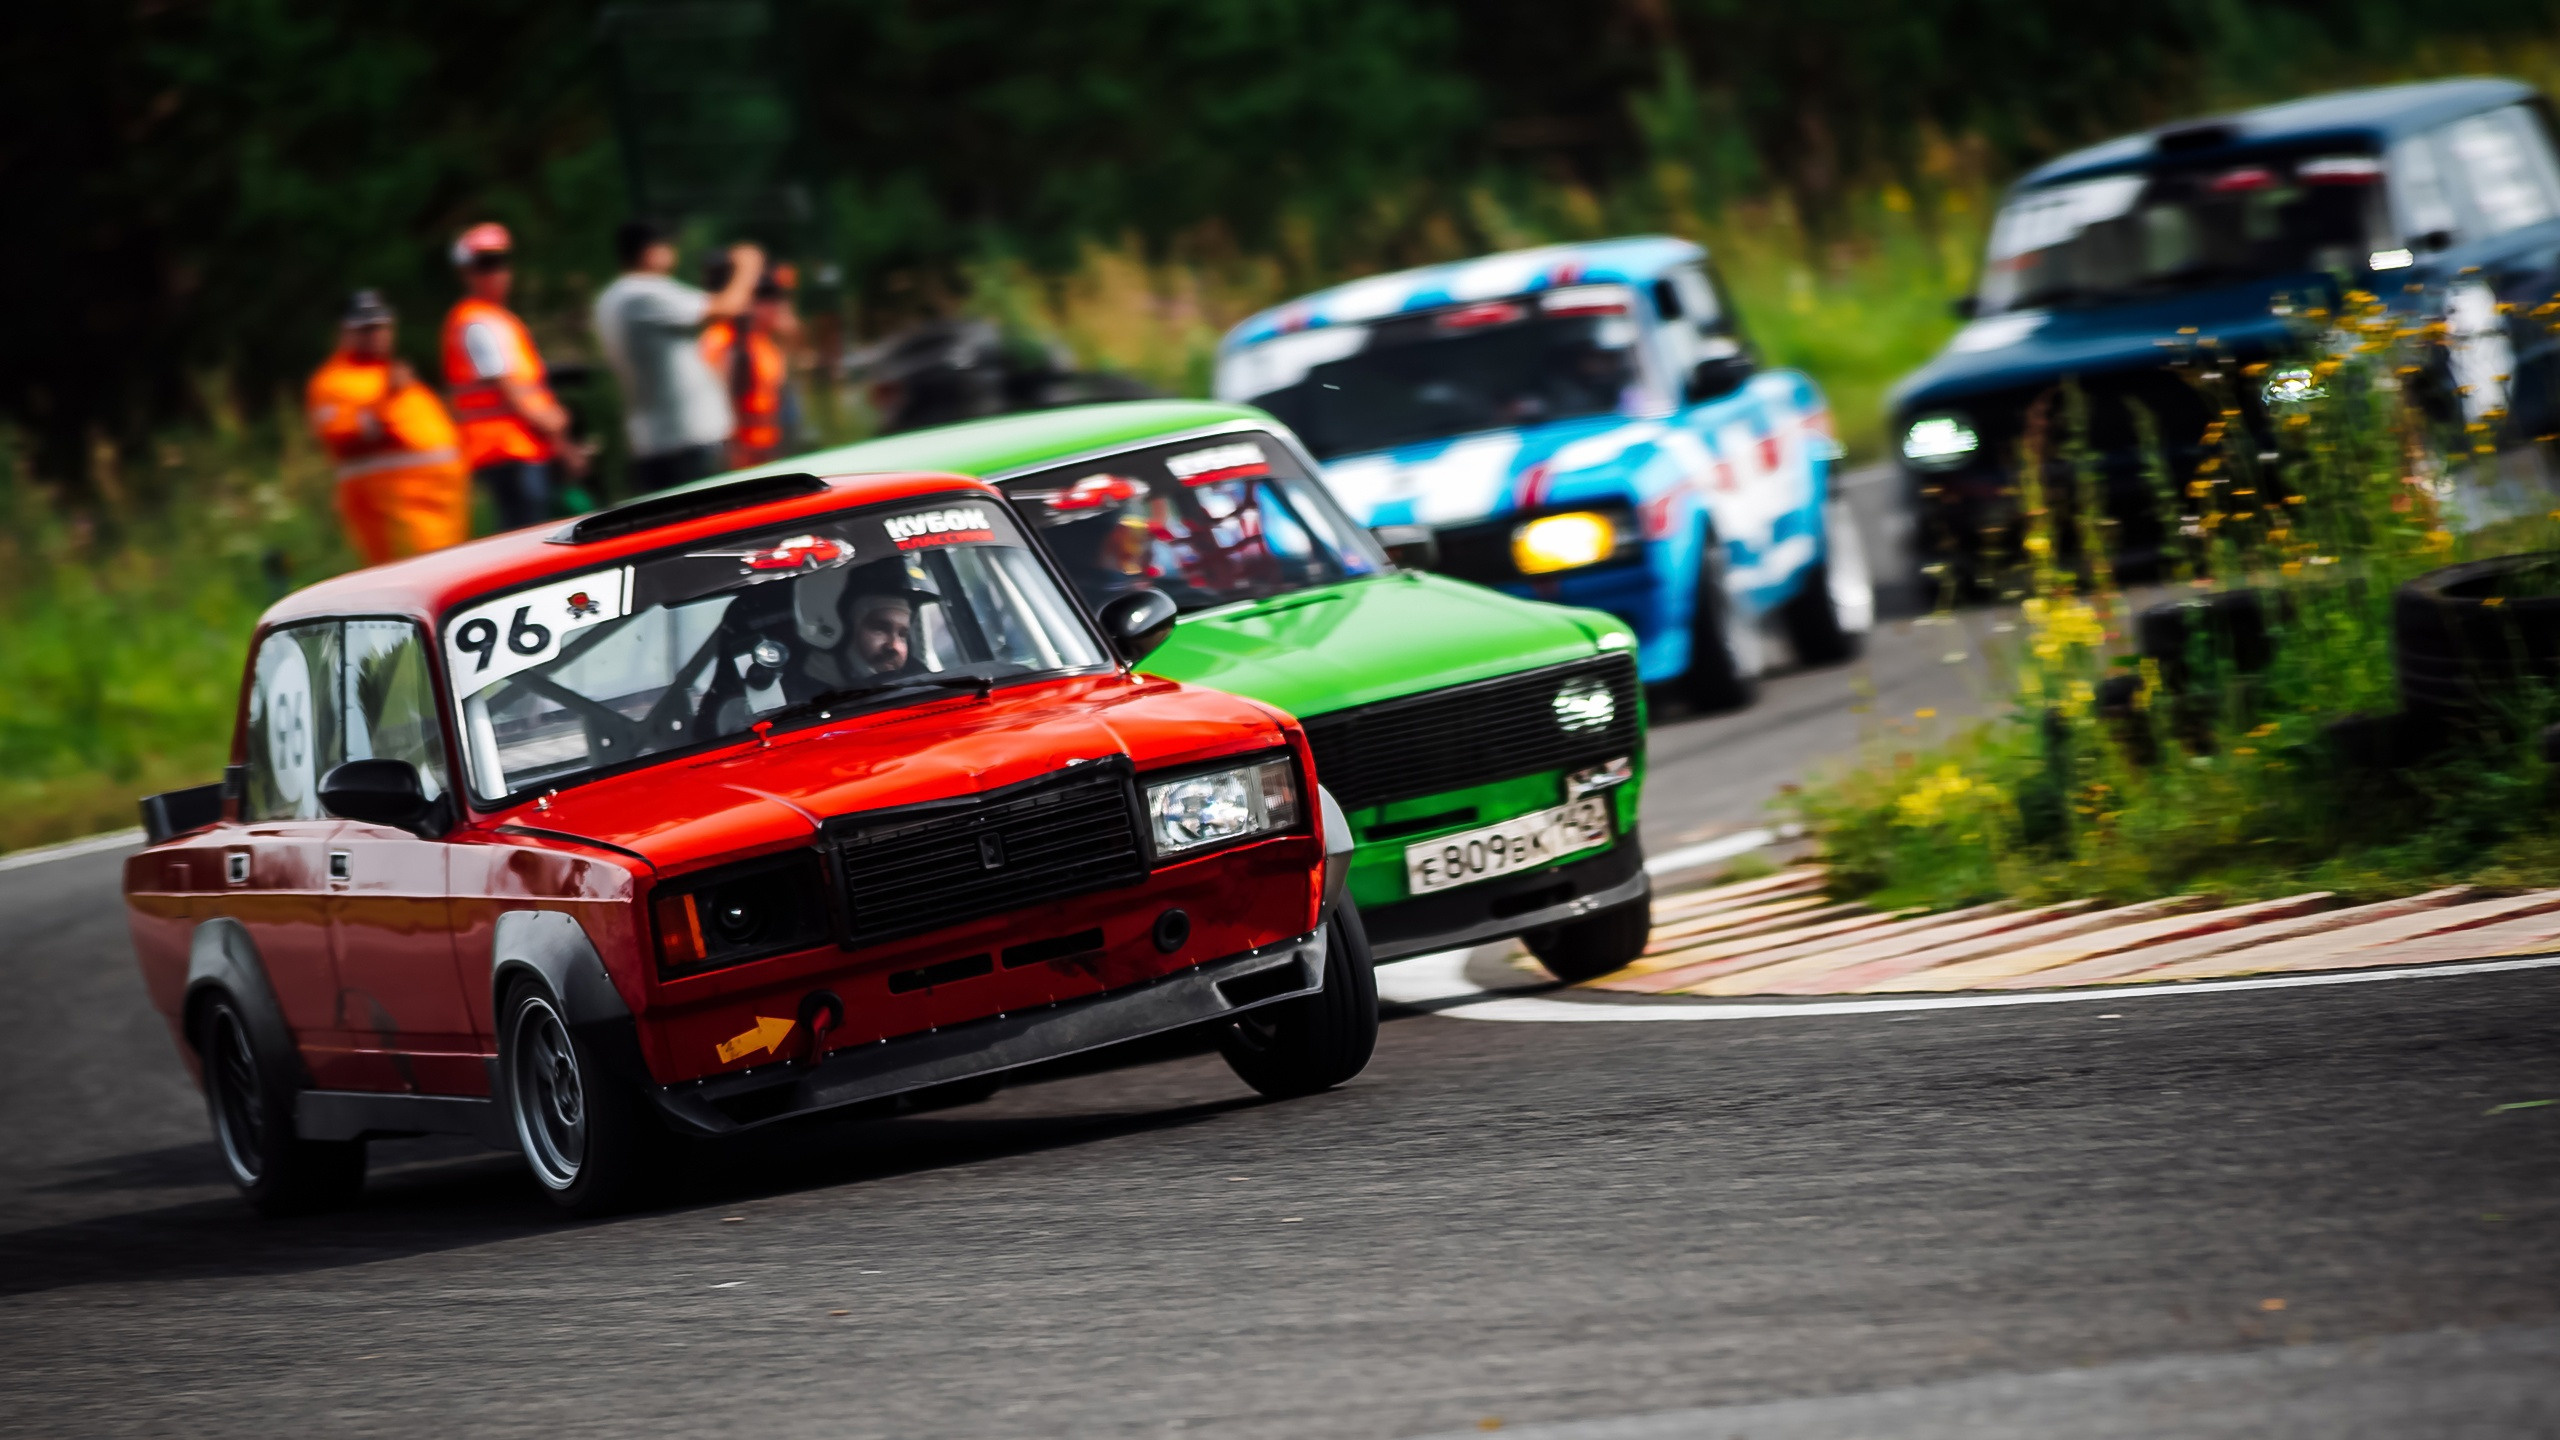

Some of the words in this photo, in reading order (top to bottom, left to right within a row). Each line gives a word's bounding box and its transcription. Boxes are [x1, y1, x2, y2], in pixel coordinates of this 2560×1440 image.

[884, 509, 990, 541] КУБОК
[455, 605, 552, 674] 96
[274, 691, 306, 769] 96
